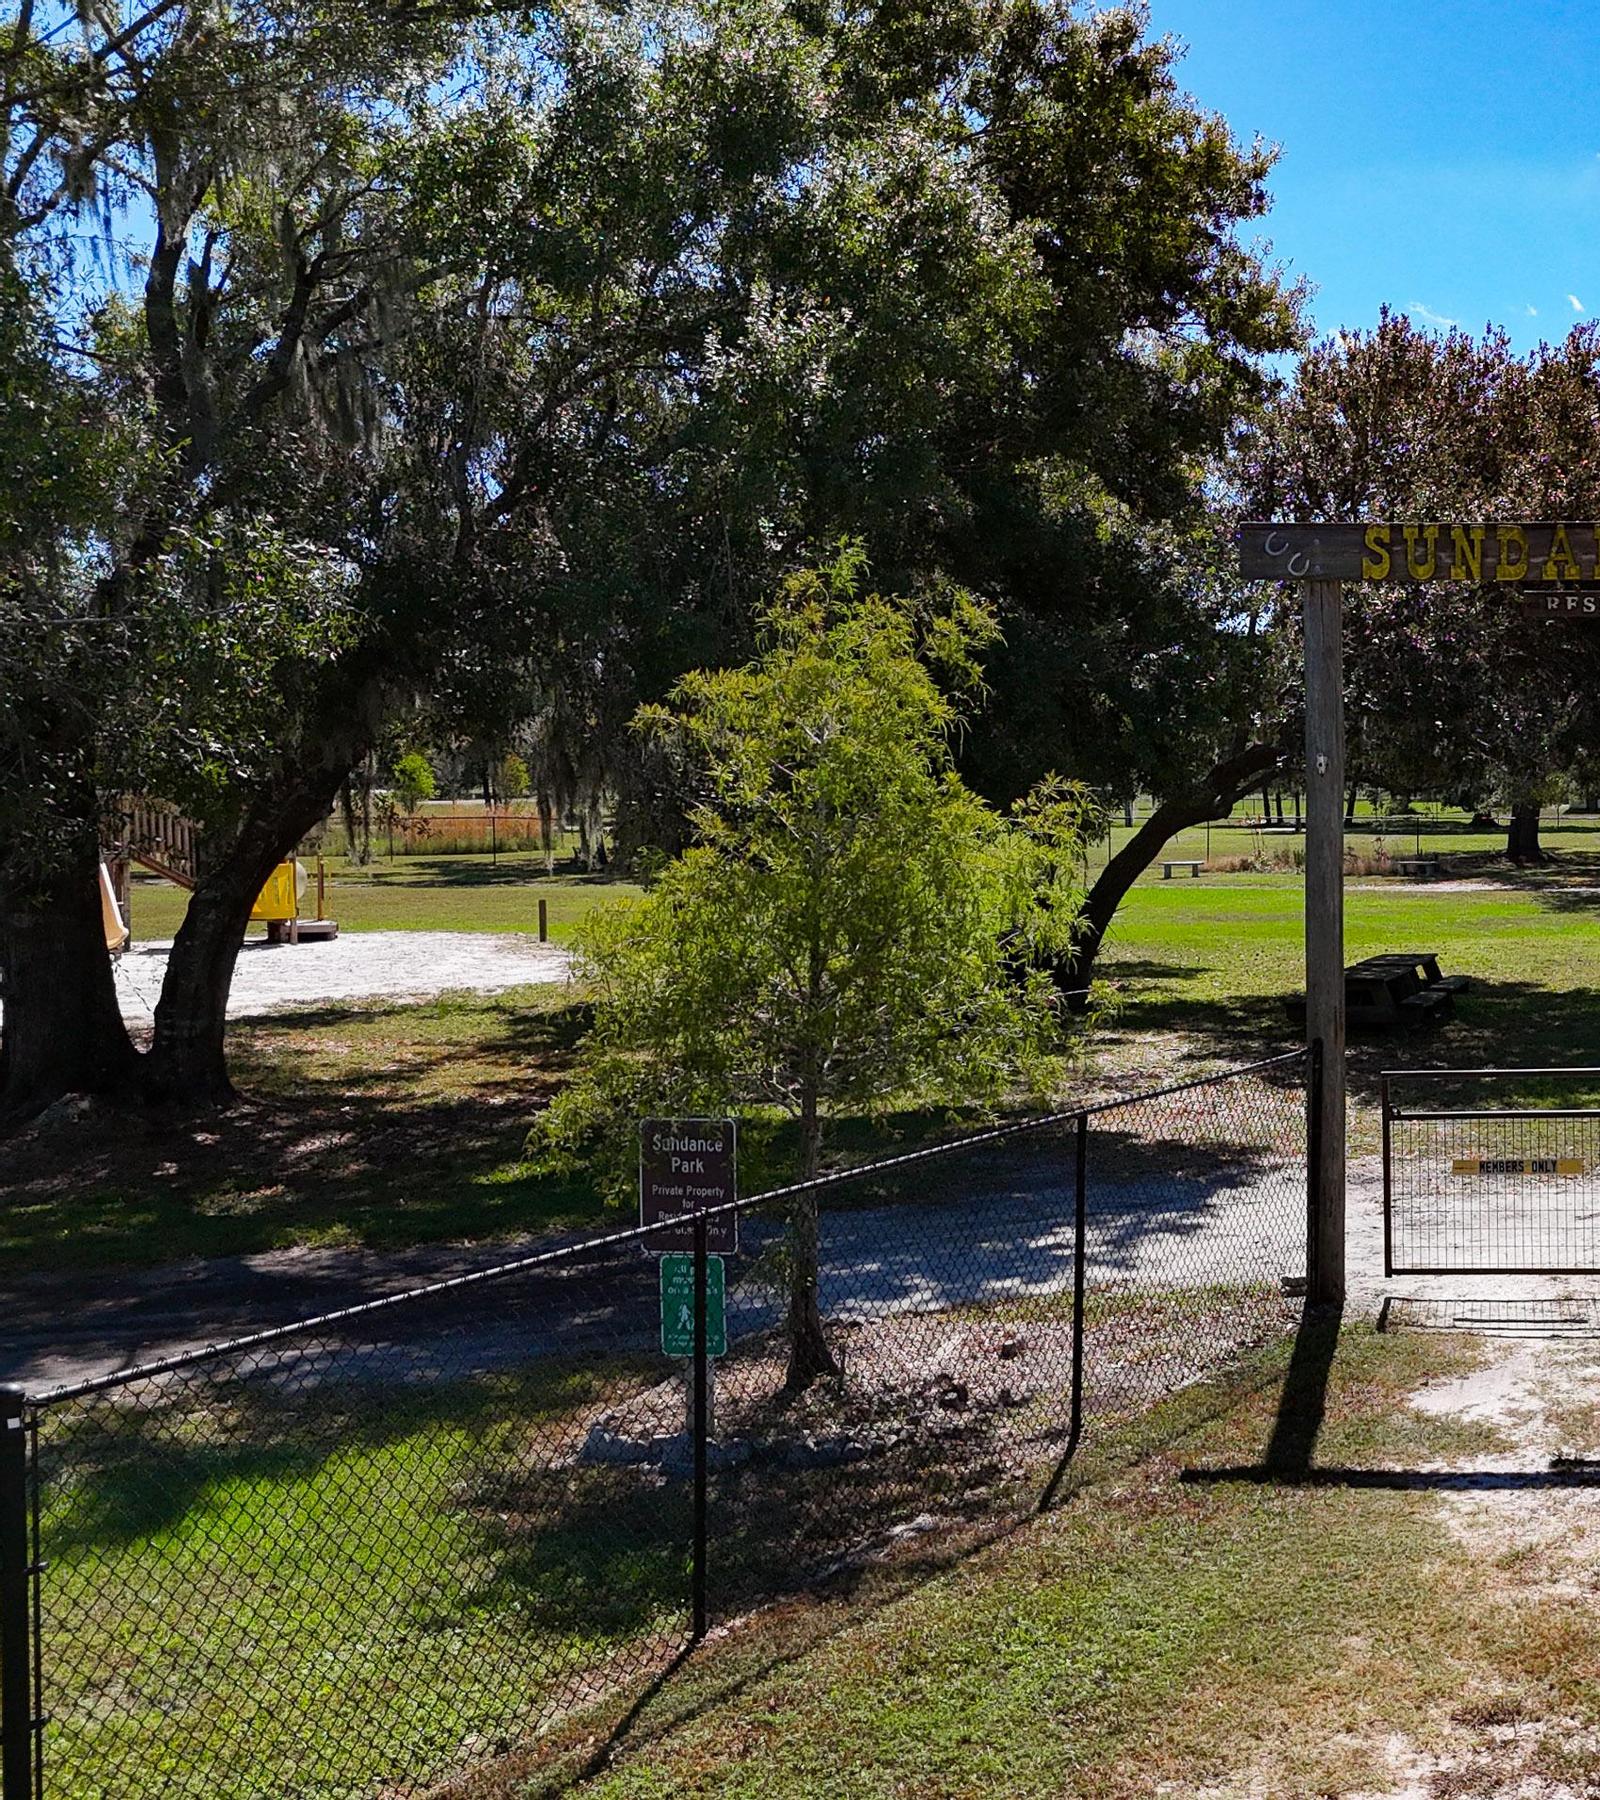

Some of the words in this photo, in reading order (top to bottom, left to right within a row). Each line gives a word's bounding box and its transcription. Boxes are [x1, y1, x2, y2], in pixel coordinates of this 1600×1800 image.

[652, 1133, 723, 1152] Sundance
[671, 1157, 705, 1173] Park
[1479, 1159, 1524, 1174] MEMBERS
[1531, 1159, 1558, 1174] ONLY
[652, 1183, 684, 1196] Private
[686, 1184, 725, 1198] Property
[682, 1198, 696, 1209] for
